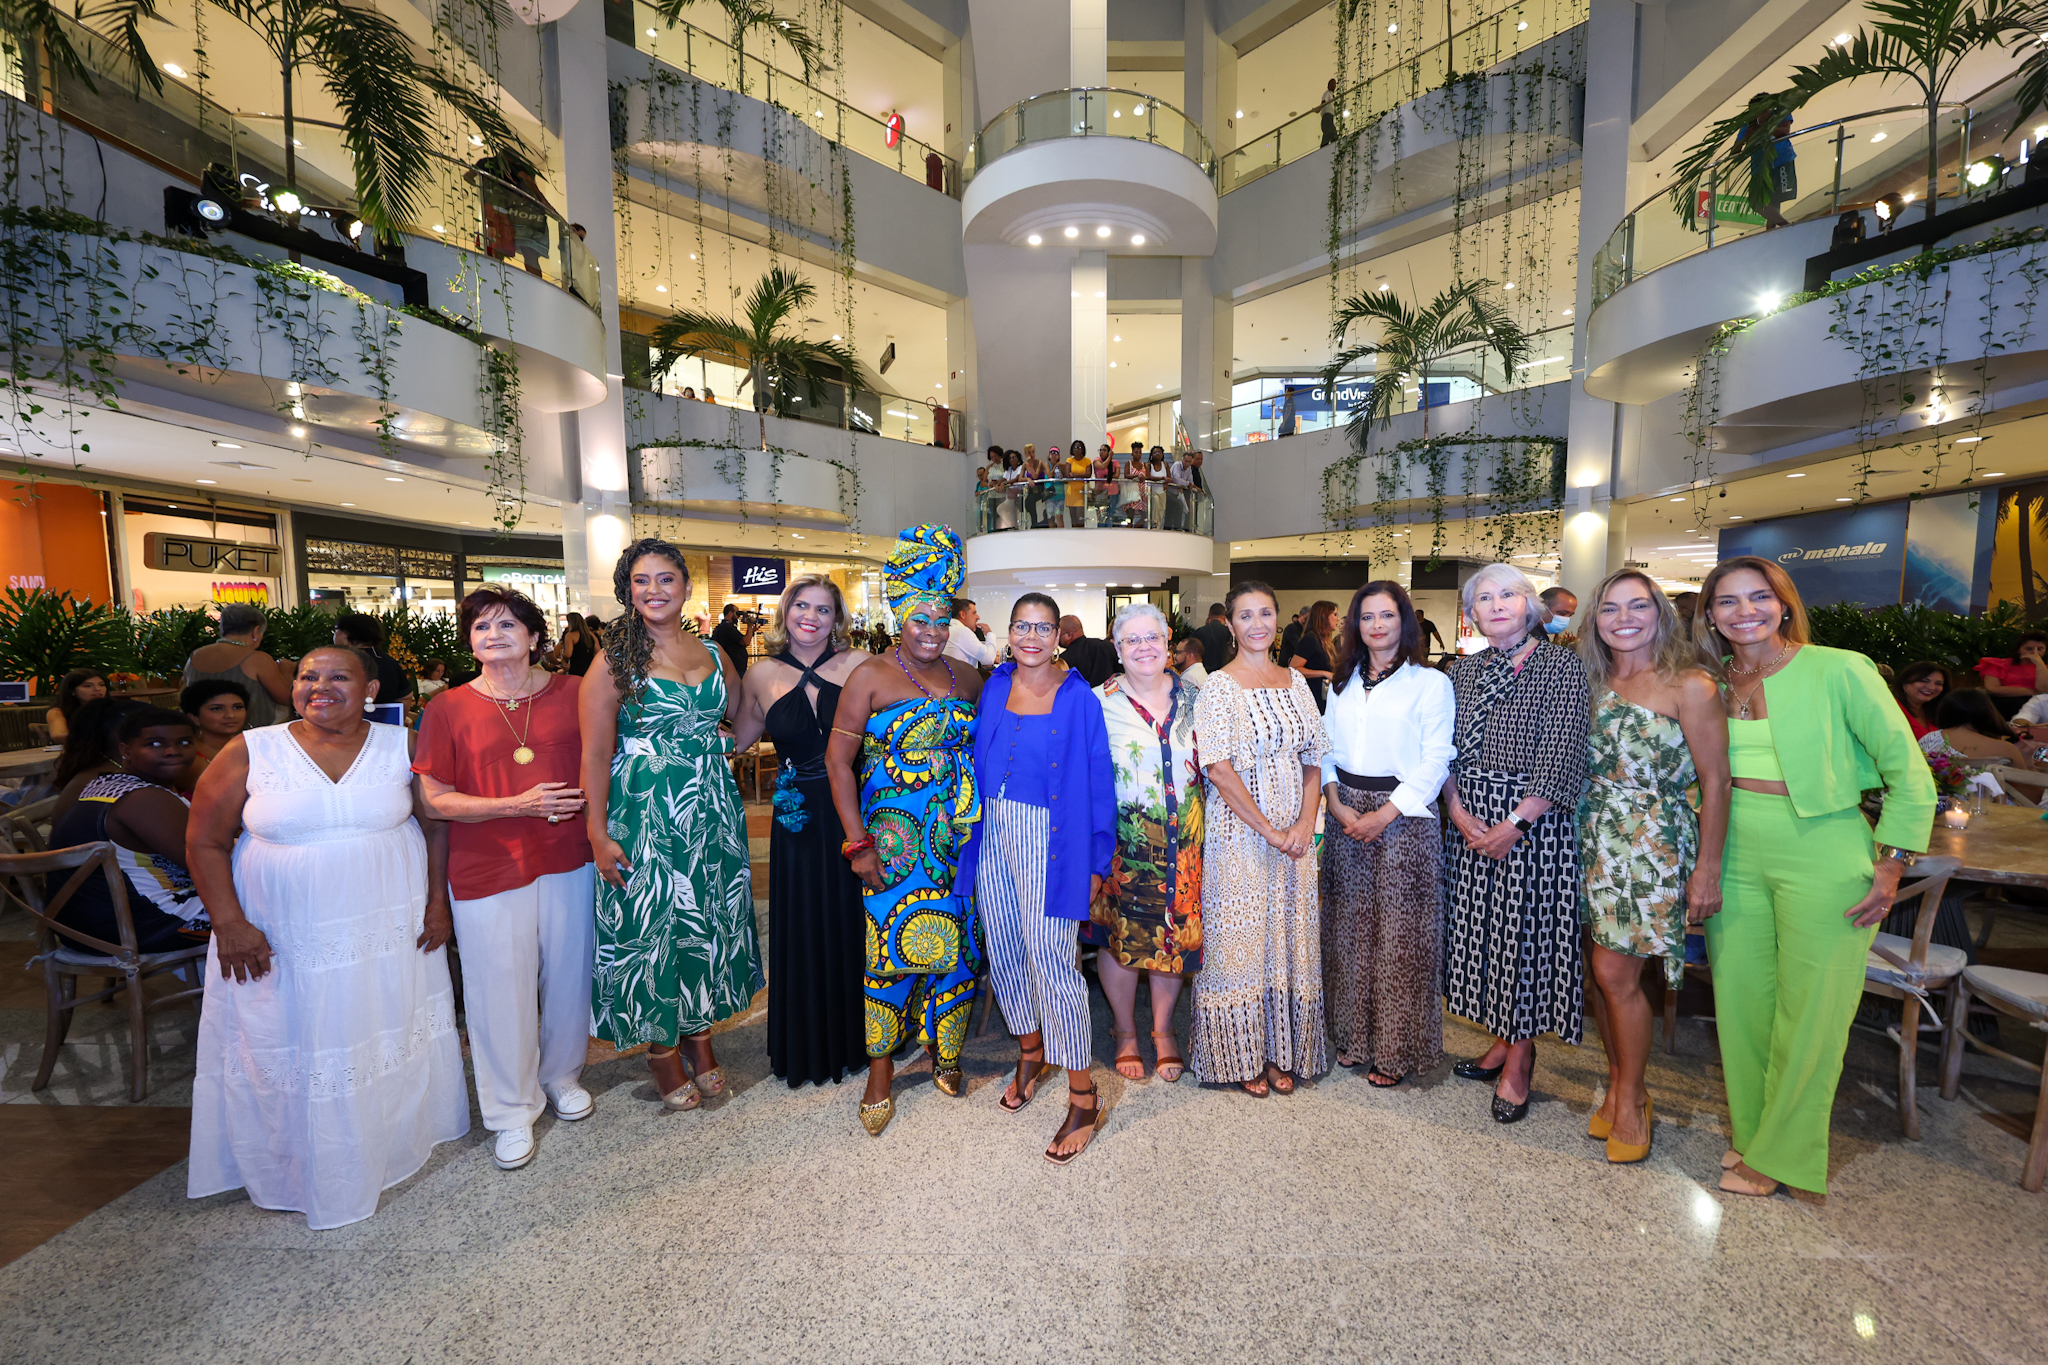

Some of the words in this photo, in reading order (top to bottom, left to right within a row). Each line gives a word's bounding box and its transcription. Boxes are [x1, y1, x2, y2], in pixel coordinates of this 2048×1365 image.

[508, 207, 545, 223] HOPE
[854, 406, 874, 426] MAC
[163, 541, 278, 573] PUKET
[1803, 541, 1888, 560] mahalo
[742, 566, 778, 584] His
[212, 582, 268, 603] LIQUIDA
